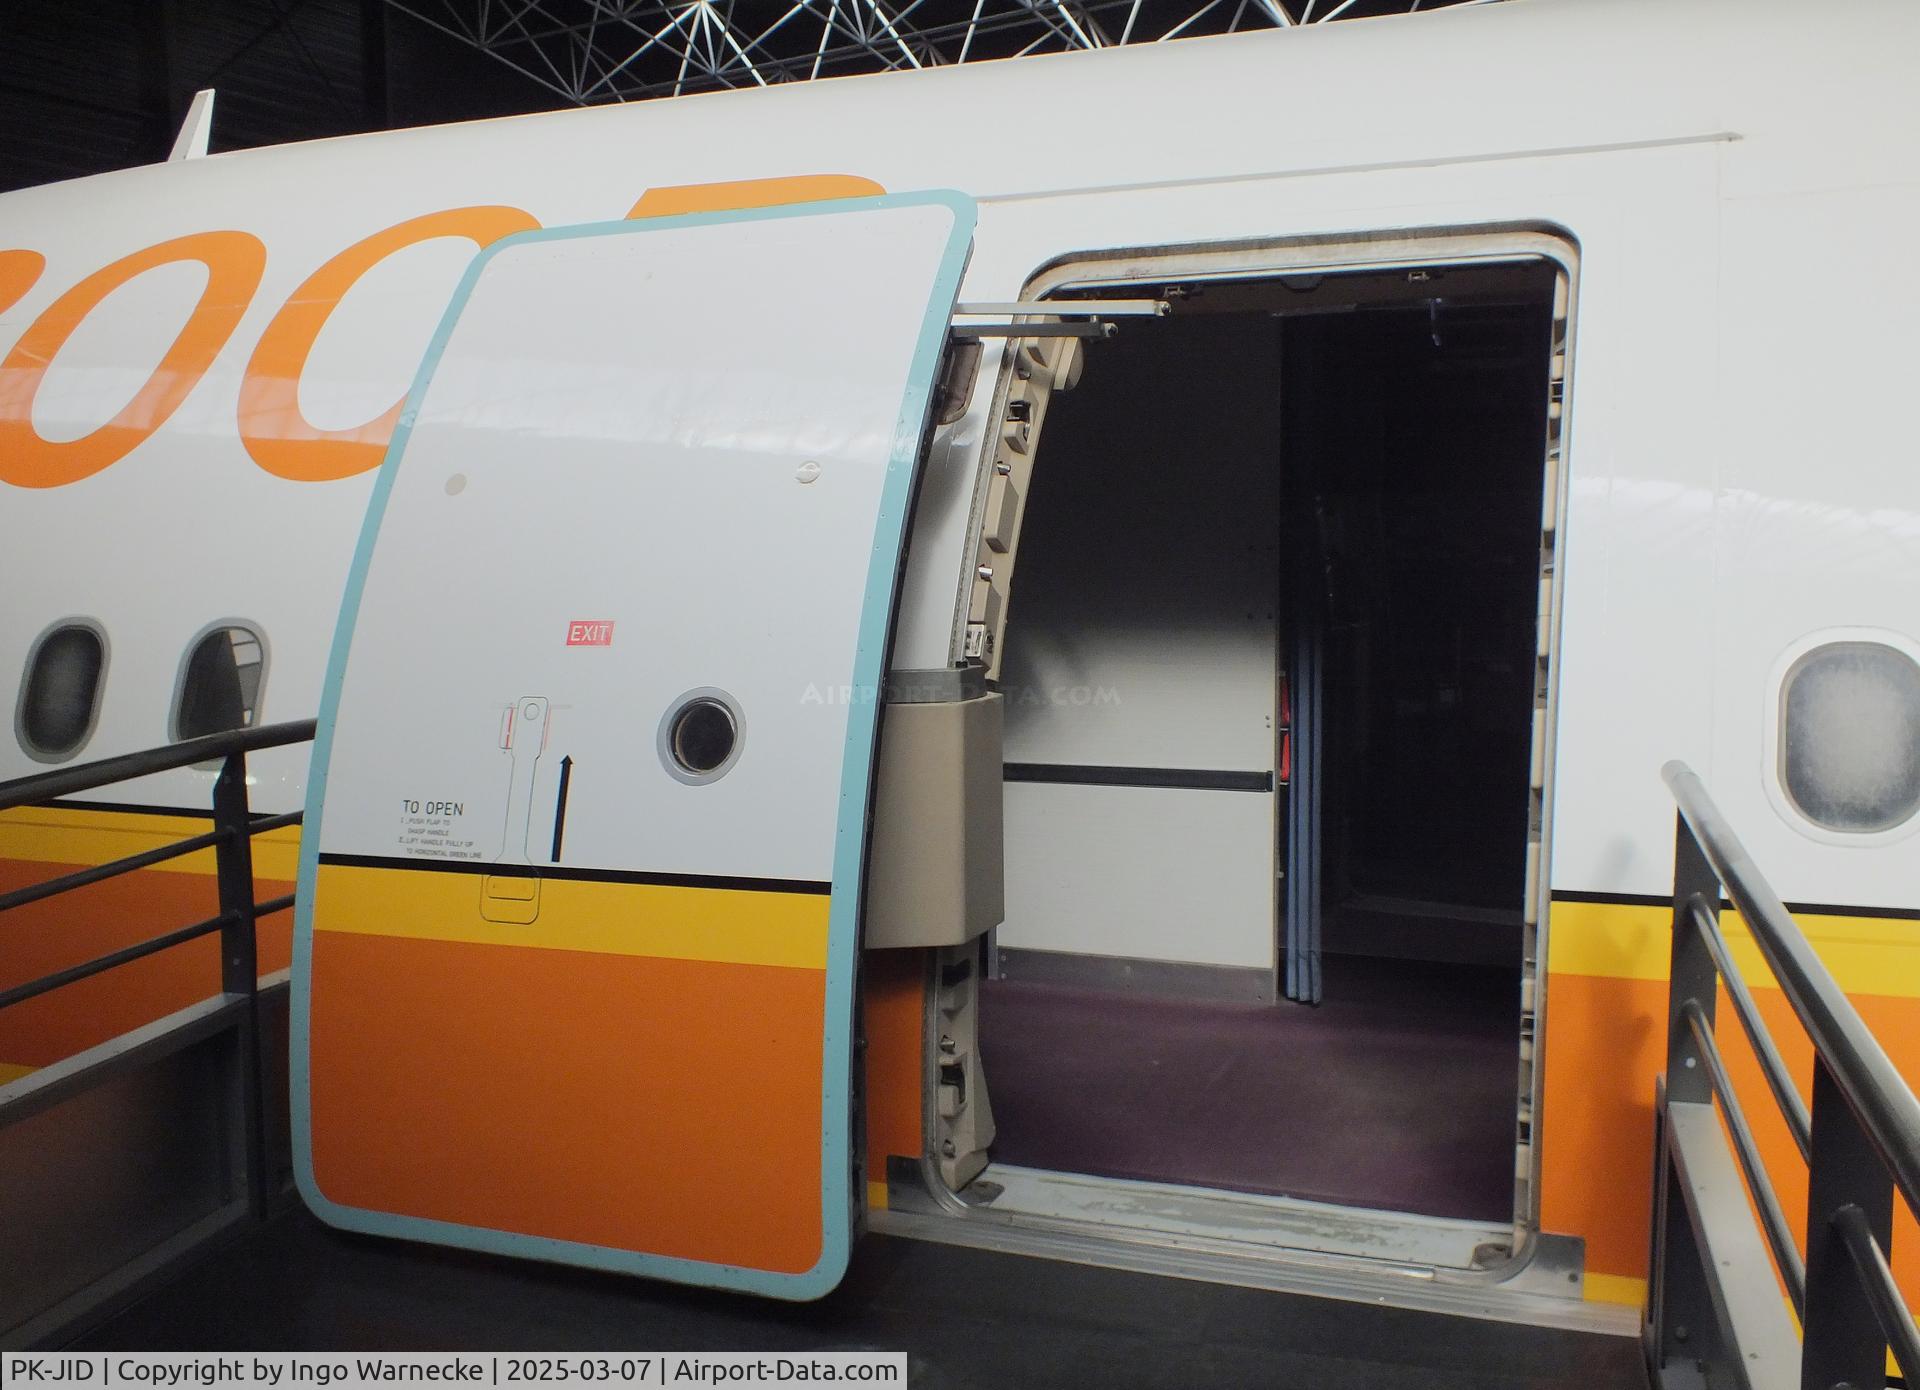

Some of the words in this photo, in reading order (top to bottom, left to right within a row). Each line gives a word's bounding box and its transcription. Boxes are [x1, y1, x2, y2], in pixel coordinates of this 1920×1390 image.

[571, 624, 609, 641] EXIT
[403, 799, 420, 814] TO
[426, 801, 464, 816] OPEN
